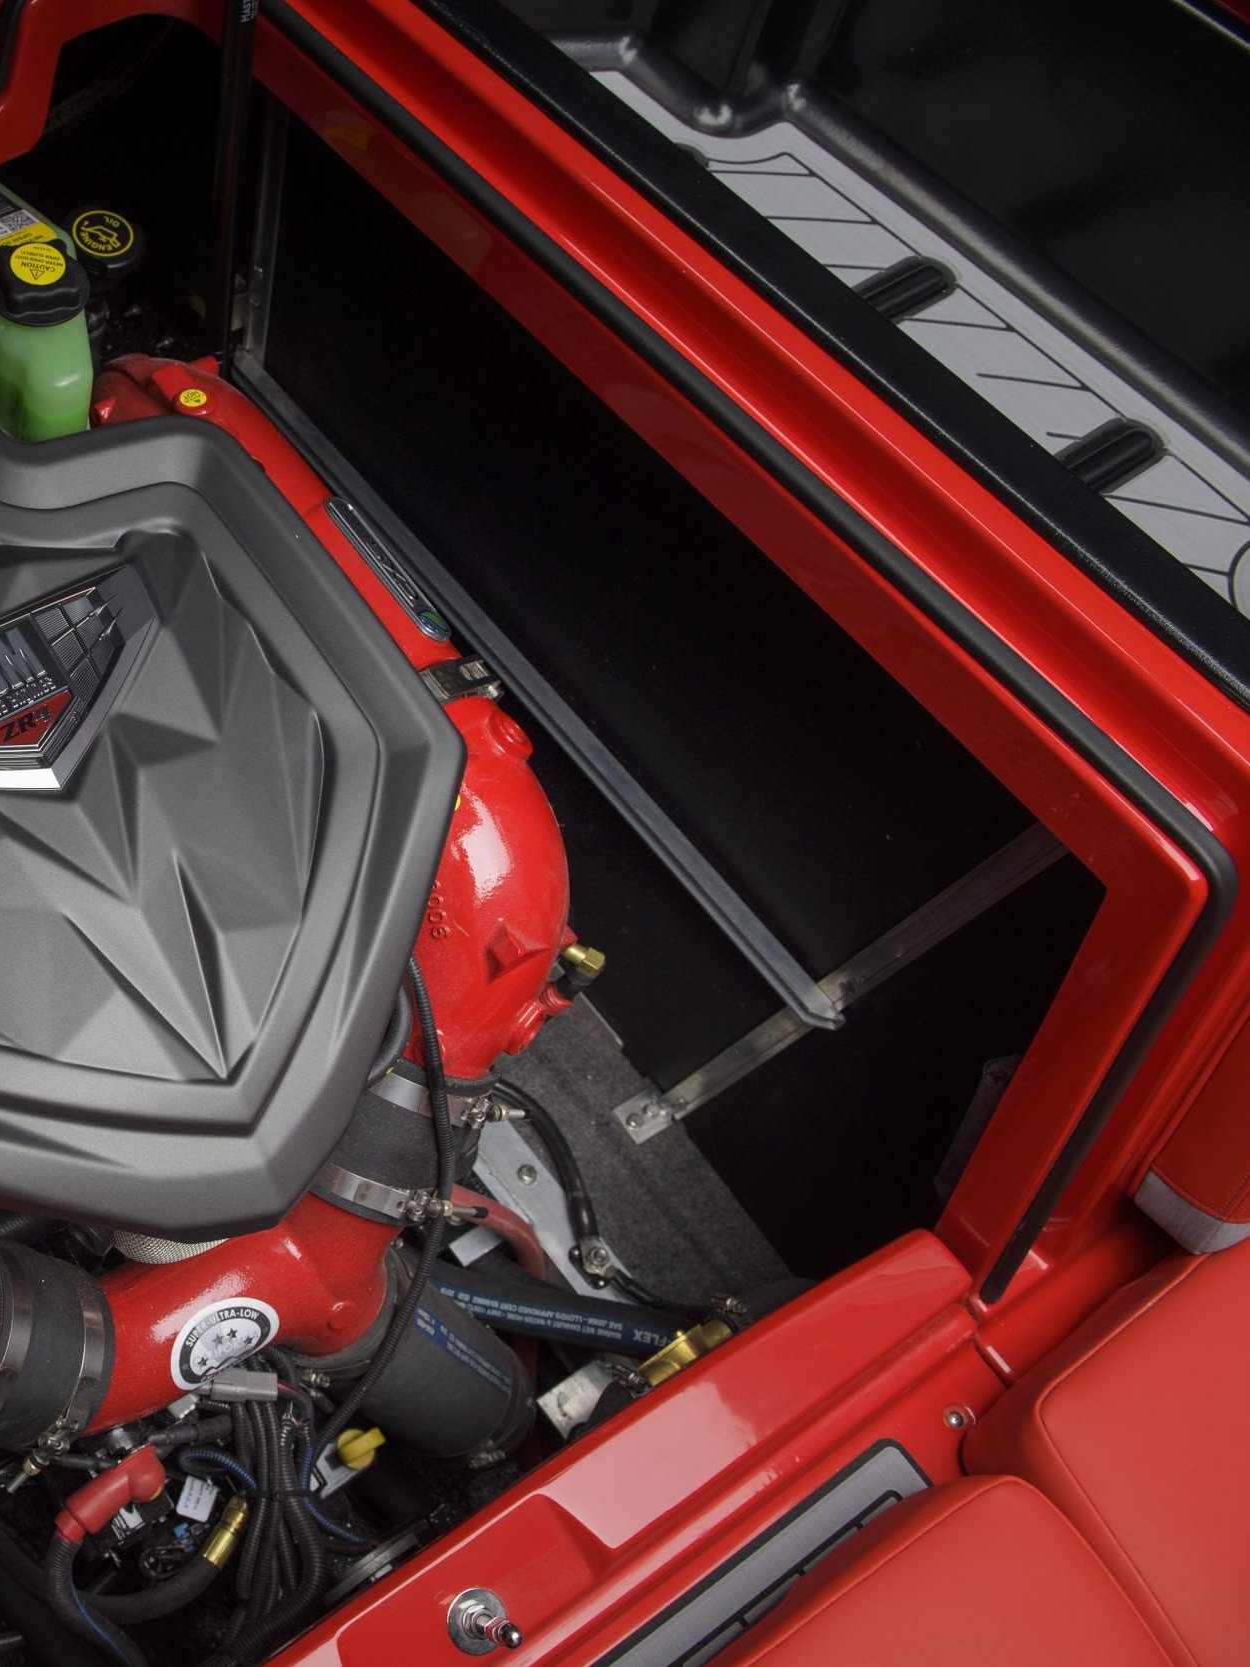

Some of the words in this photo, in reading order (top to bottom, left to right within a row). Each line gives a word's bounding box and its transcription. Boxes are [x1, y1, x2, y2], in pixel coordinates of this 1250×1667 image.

[103, 216, 120, 228] OIL
[80, 230, 113, 251] ENGINE
[20, 260, 55, 272] CAUTION
[4, 676, 56, 708] ENGINES
[0, 703, 49, 742] ZR4
[506, 1311, 523, 1321] HOSE
[516, 1304, 554, 1318] APPROVED
[524, 1314, 544, 1325] WATER
[552, 1319, 580, 1332] EXHAUST
[608, 1321, 622, 1330] SAE
[186, 1309, 259, 1348] SUPER-ULTRA-LOW
[582, 1325, 595, 1335] WET
[596, 1328, 621, 1339] MARINE
